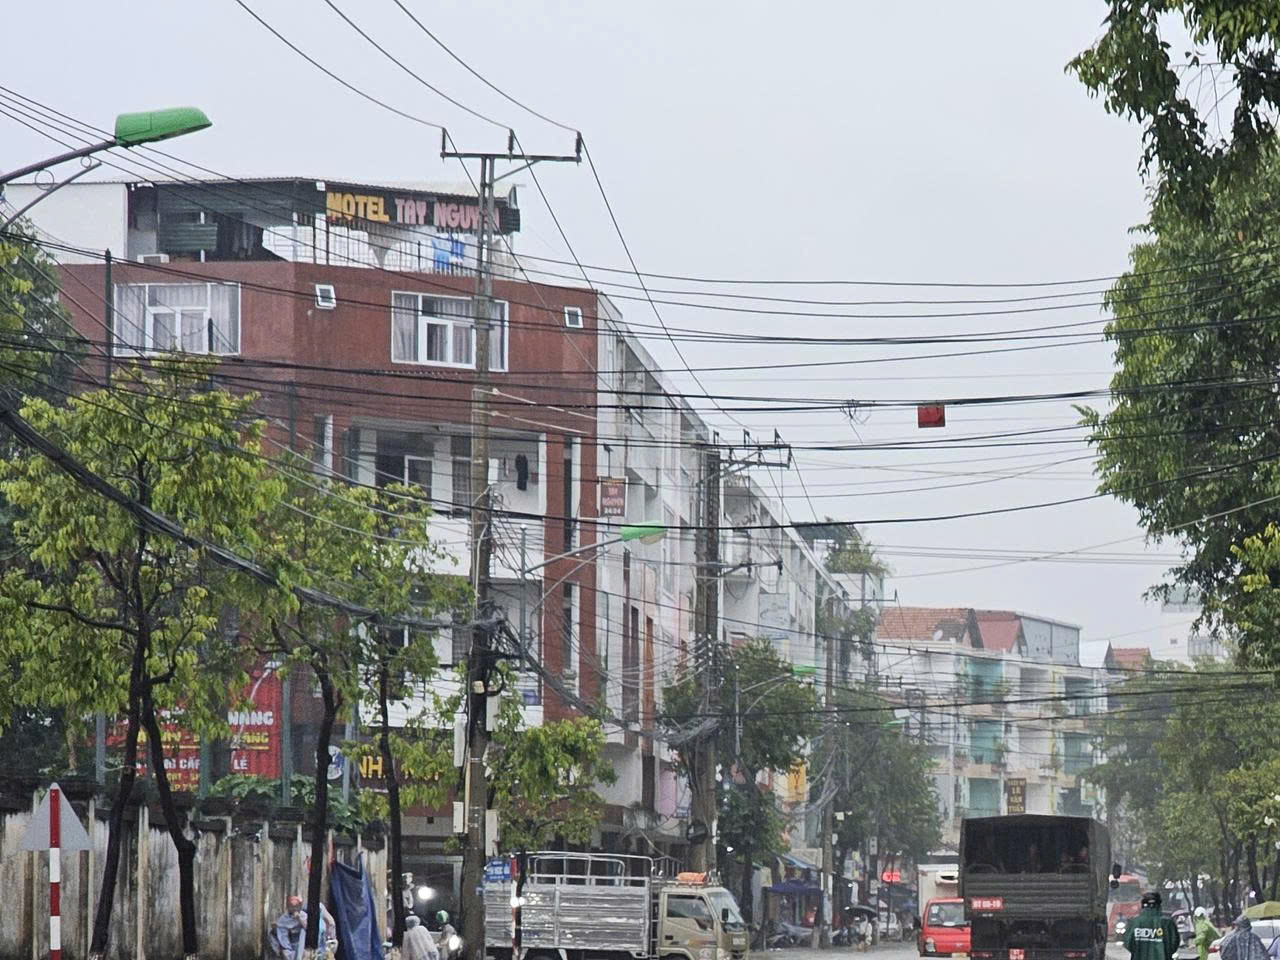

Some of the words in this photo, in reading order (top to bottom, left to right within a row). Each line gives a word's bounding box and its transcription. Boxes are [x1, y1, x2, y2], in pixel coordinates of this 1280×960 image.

[327, 191, 390, 222] MOTEL
[433, 201, 500, 231] NGUYN
[1134, 927, 1157, 938] BIDV
